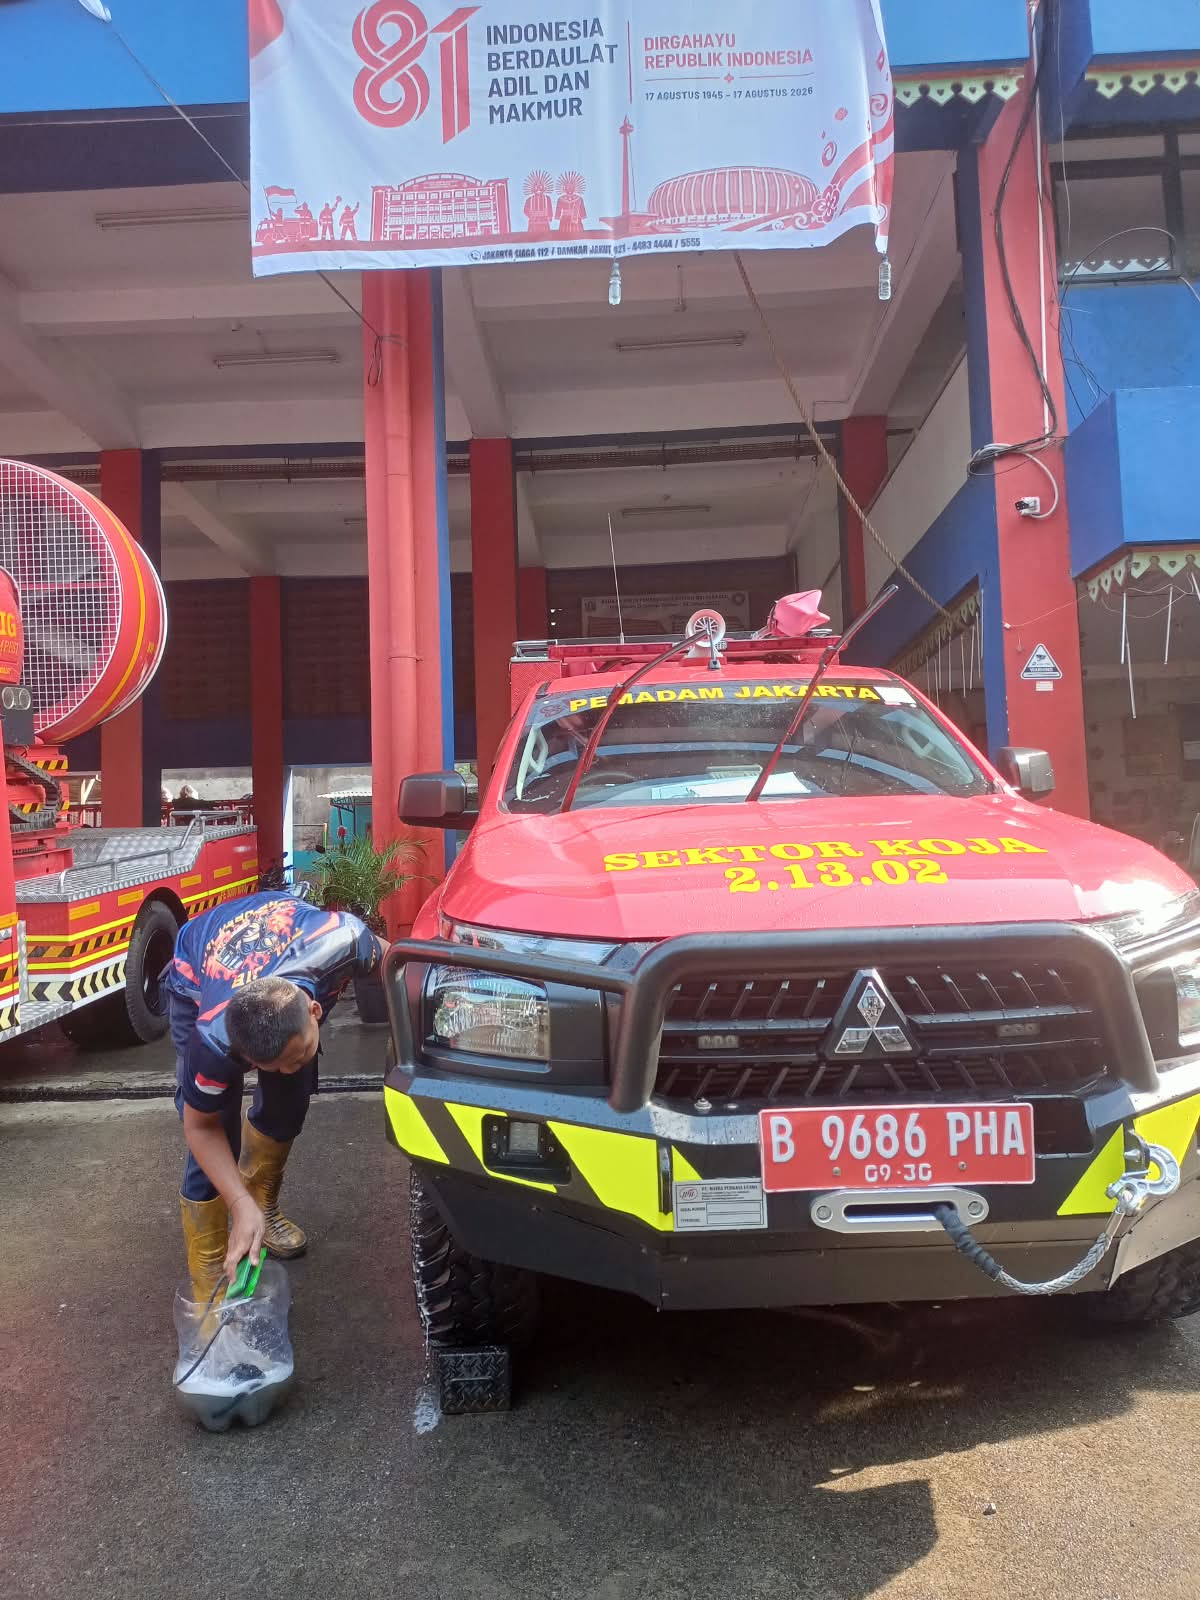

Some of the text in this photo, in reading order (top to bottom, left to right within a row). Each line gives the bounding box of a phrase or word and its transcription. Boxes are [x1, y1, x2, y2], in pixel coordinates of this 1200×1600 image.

[487, 17, 604, 46] INDONESIA
[643, 33, 736, 51] DIRGAHAYU
[487, 43, 618, 72] BERDAULAT
[644, 48, 814, 69] REPUBLIK INDONESIA
[352, 0, 482, 144] 81
[488, 70, 590, 98] ADIL DAN
[645, 92, 654, 100] 17
[656, 91, 700, 100] AGUSTUS
[703, 90, 724, 99] 1945
[734, 90, 742, 99] 17
[745, 88, 788, 98] AGUSTUS
[790, 86, 813, 96] 2026
[489, 97, 583, 125] MAKMUR
[482, 249, 513, 260] JAKARTA
[515, 248, 535, 258] SIAGA
[537, 247, 549, 257] 112
[557, 245, 588, 256] DAMKAR
[632, 239, 652, 250] 4483
[653, 239, 673, 248] 4444
[680, 238, 700, 248] 5555
[734, 685, 880, 700] JAKARTA
[603, 836, 1049, 872] SEKTOR KOJA
[724, 858, 948, 893] 2.13.02
[770, 1111, 1025, 1163] B 9686 PHA
